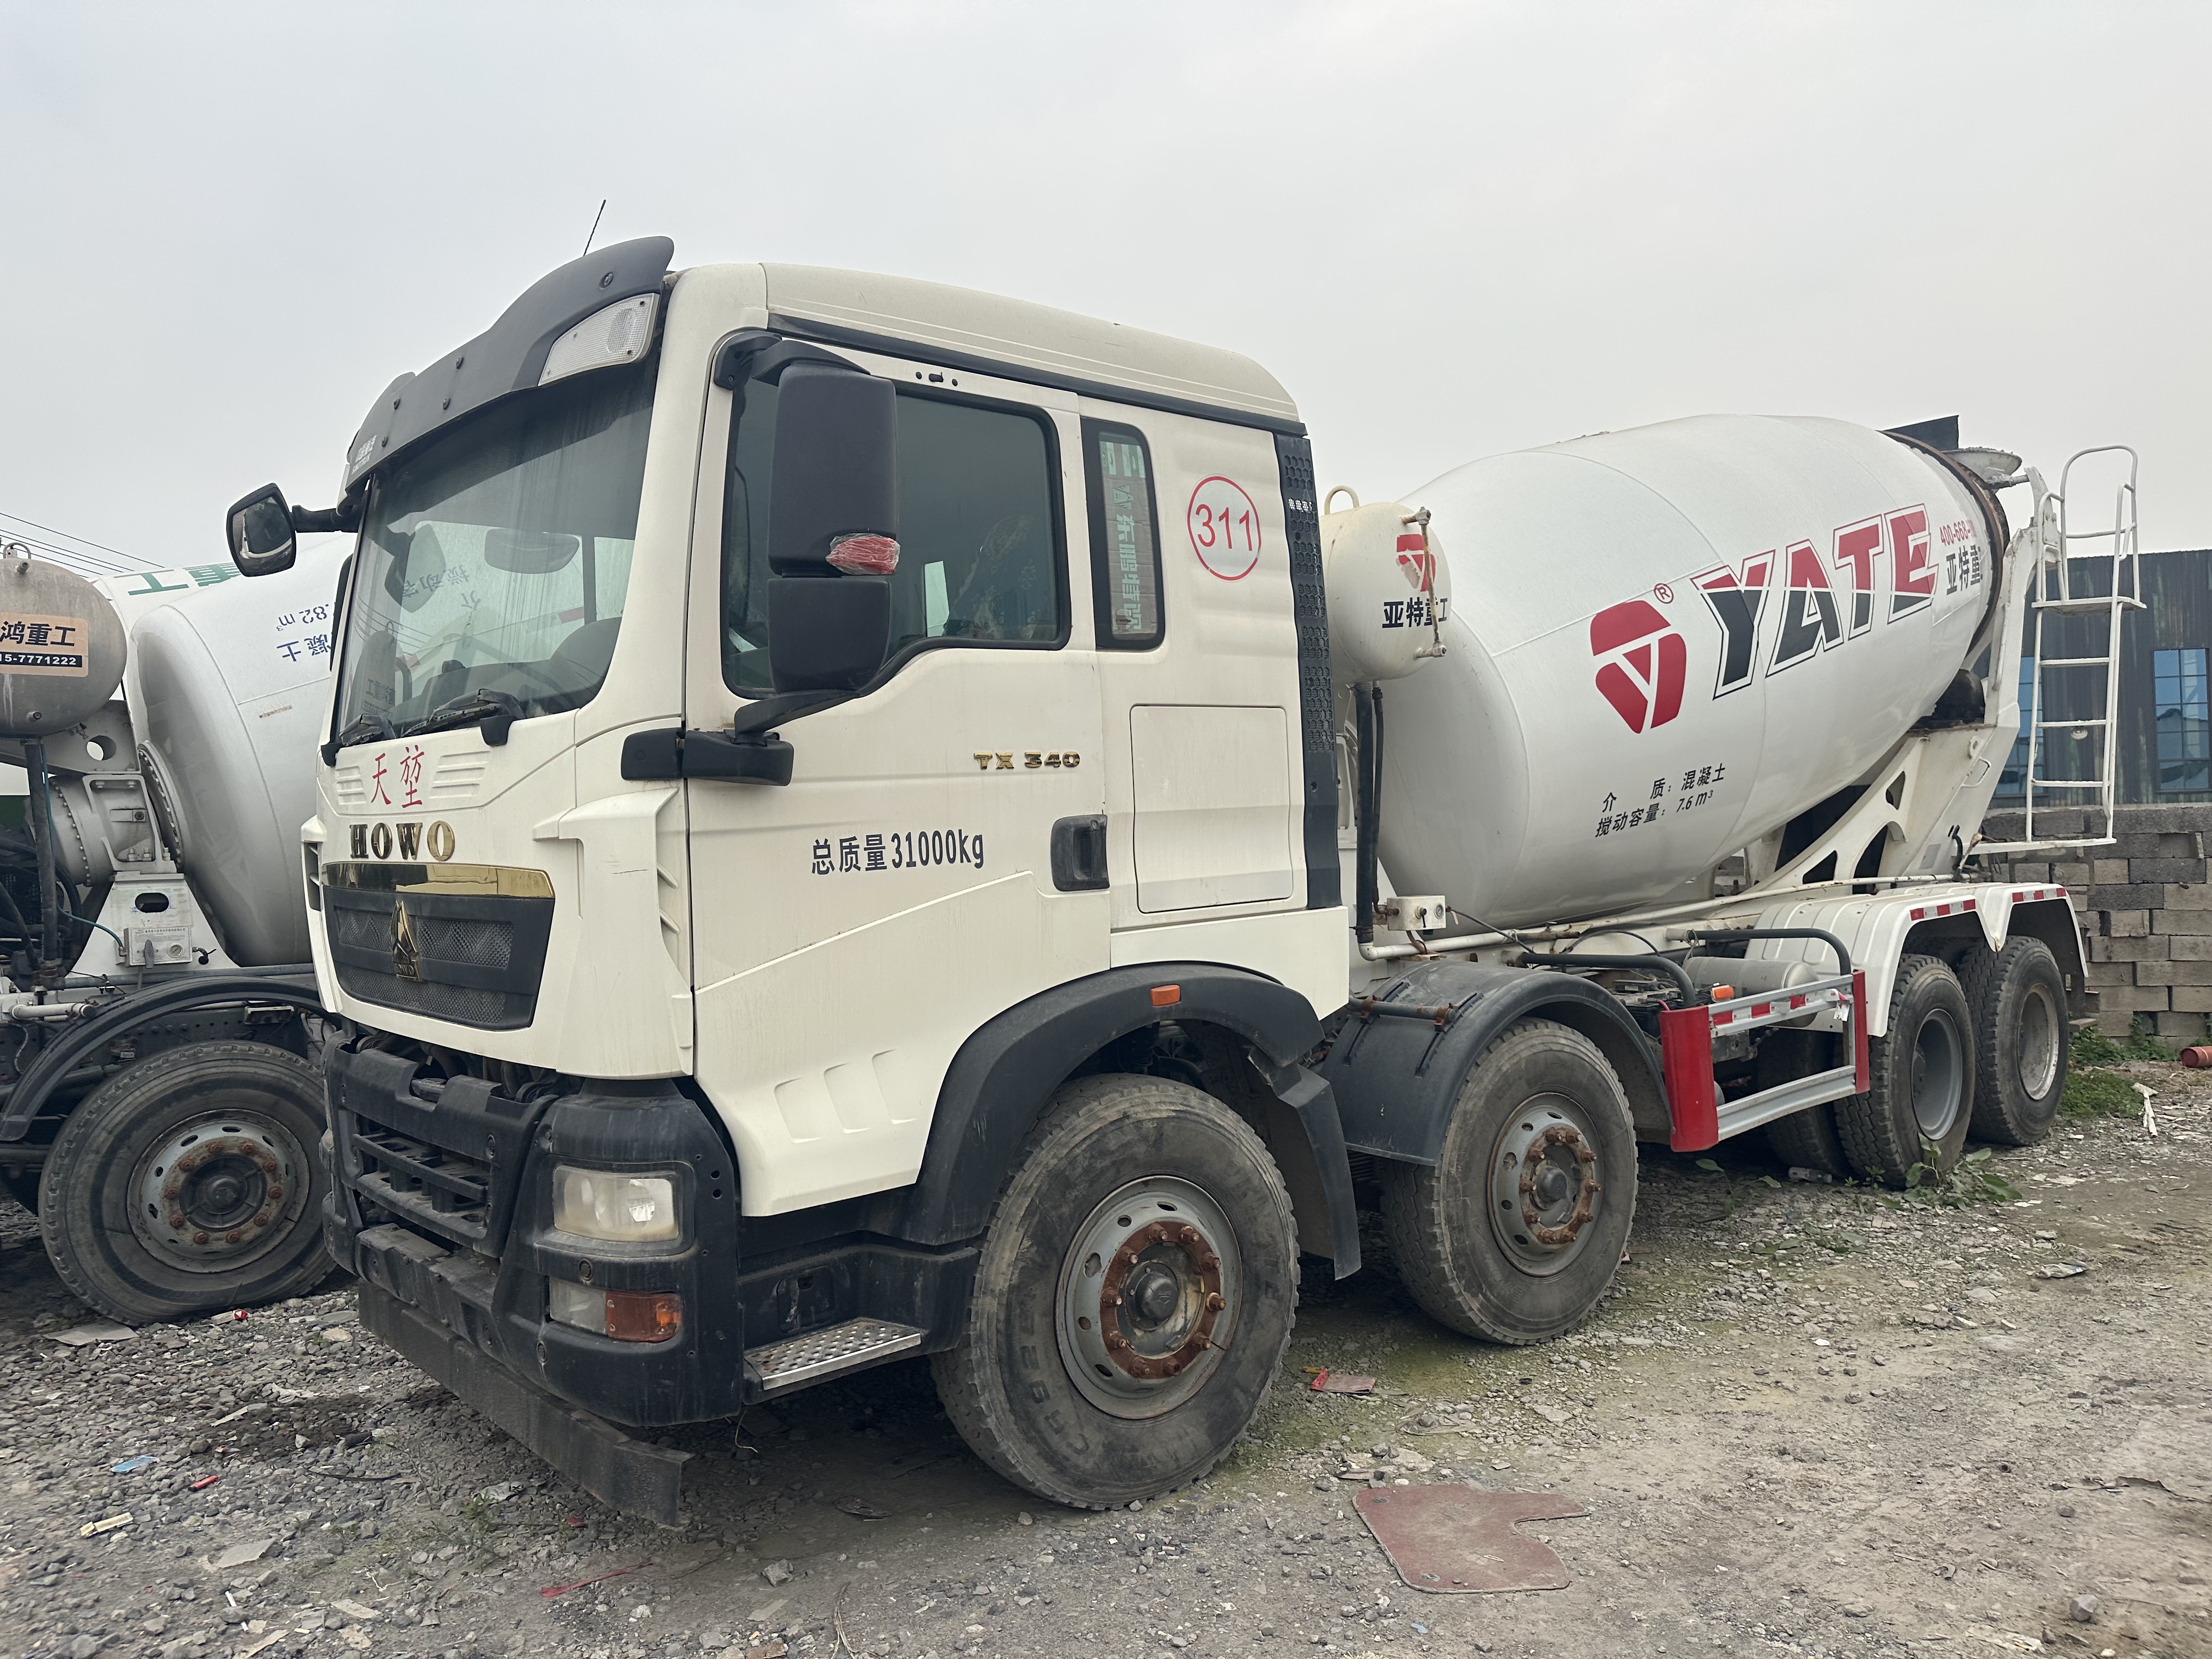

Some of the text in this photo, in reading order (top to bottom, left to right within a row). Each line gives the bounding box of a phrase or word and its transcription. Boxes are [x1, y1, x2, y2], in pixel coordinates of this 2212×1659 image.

[1195, 504, 1253, 551] 311
[1939, 519, 1977, 546] 400-668-
[1382, 596, 1448, 628] 亚特重工
[1690, 503, 1939, 700] YATE
[0, 620, 76, 646] 鸿重工
[371, 744, 425, 808] 天堃
[974, 751, 1081, 770] TX 340
[349, 820, 456, 862] HOWO
